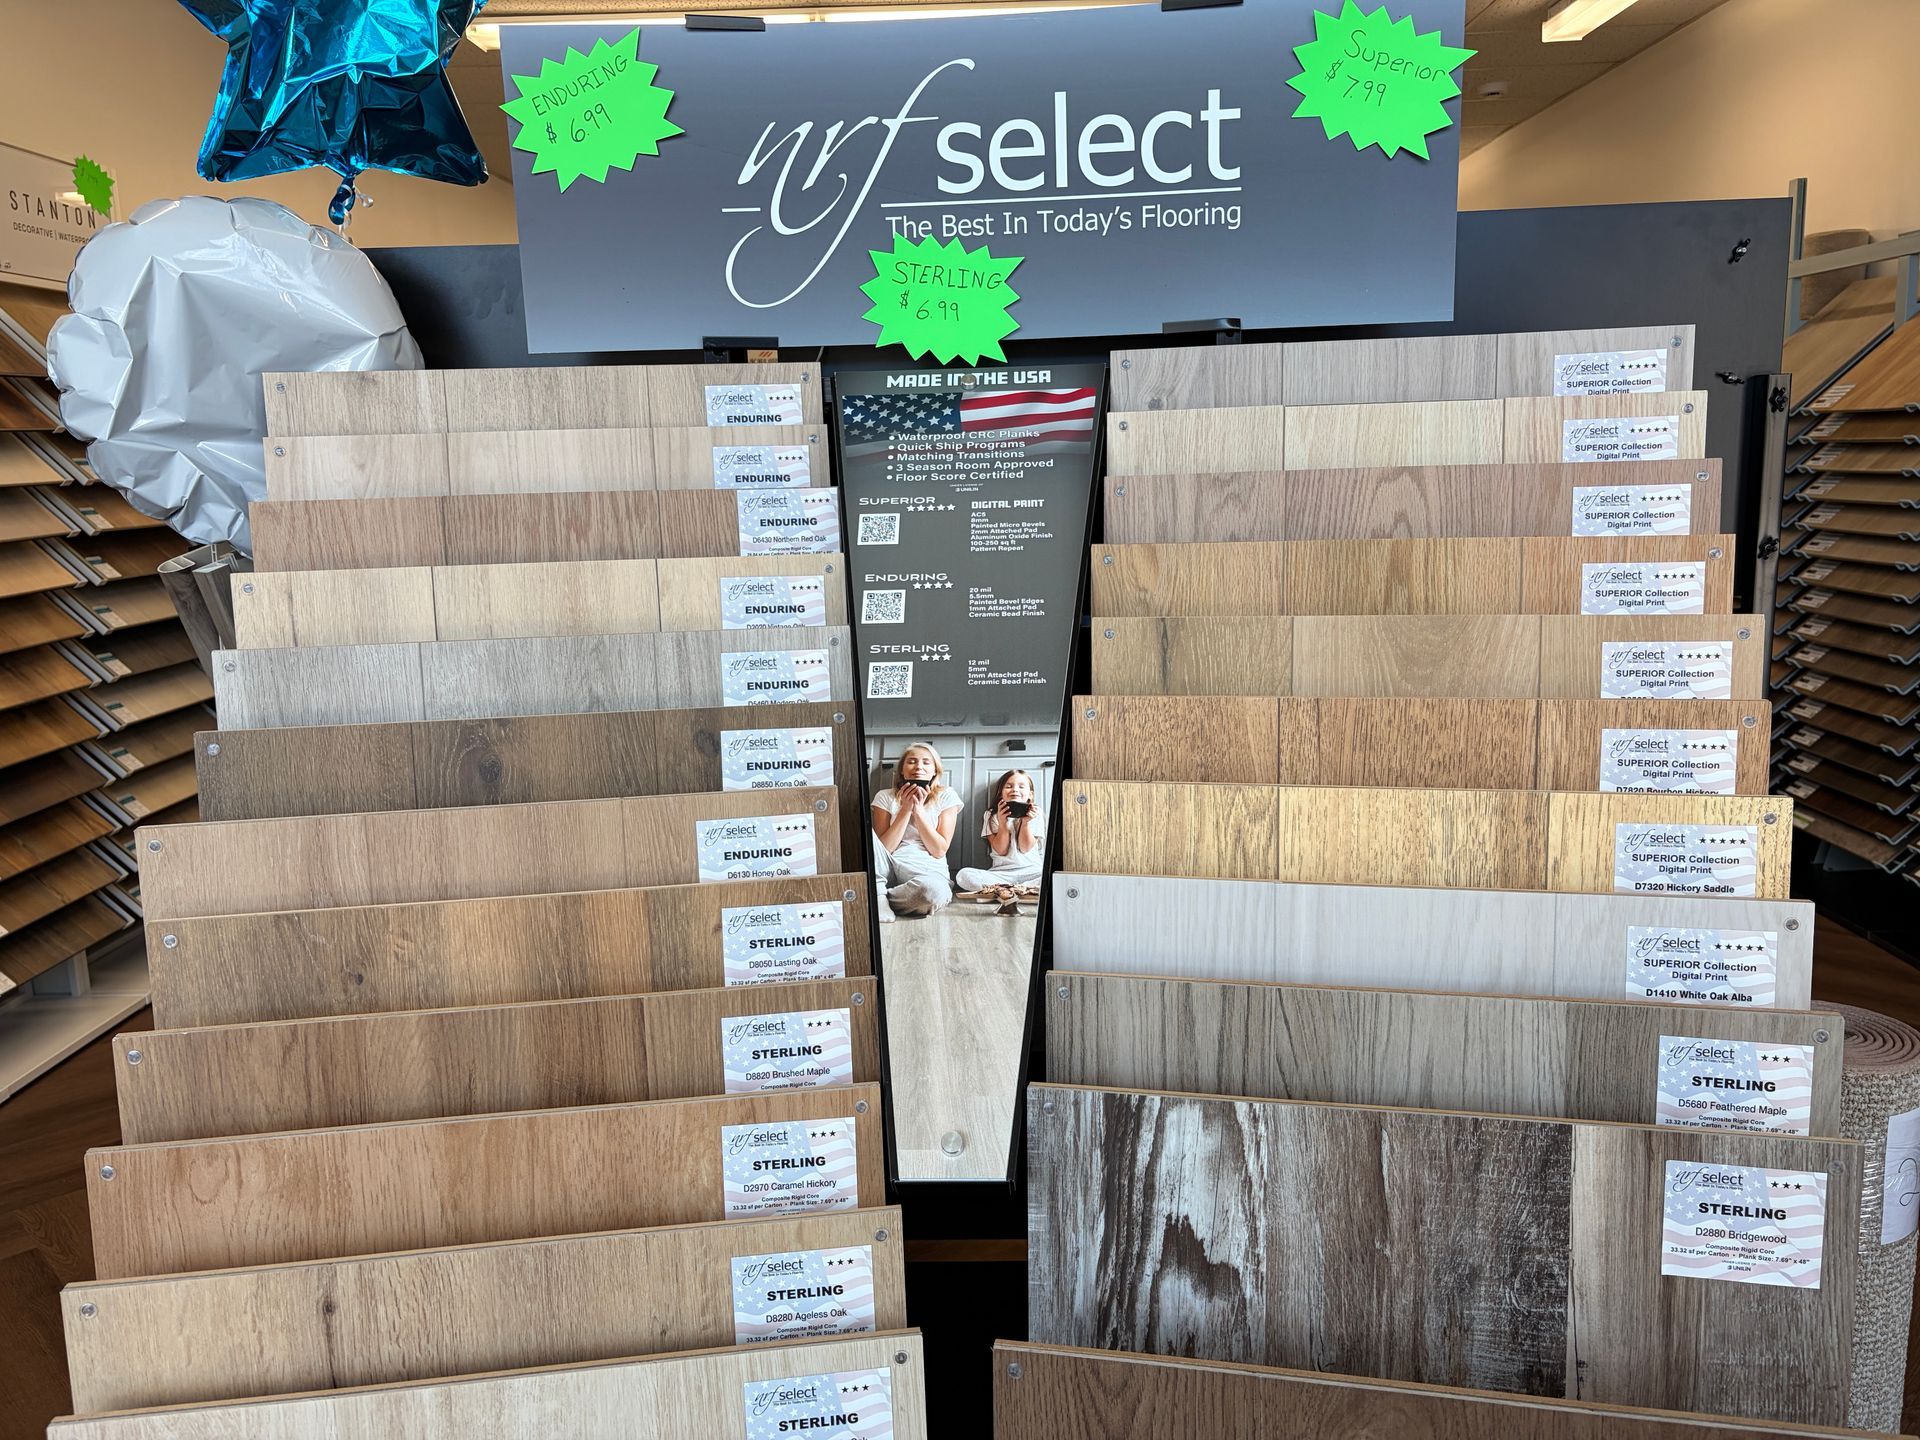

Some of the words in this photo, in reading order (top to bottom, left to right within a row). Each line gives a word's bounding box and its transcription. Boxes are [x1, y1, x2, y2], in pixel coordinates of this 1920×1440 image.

[1344, 30, 1445, 81] Superior
[532, 55, 627, 116] ENDURING
[1325, 59, 1344, 82] $
[1343, 75, 1386, 106] 7.99
[546, 122, 557, 144] $
[571, 103, 612, 142] 6.99
[936, 88, 1241, 194] select
[10, 190, 96, 229] STANTON
[886, 217, 932, 239] The
[942, 214, 994, 237] Best
[1003, 212, 1028, 234] In
[1142, 203, 1241, 230] Flooring
[13, 222, 53, 238] DECORATIVE
[892, 262, 1002, 289] STERLING
[900, 290, 909, 309] $
[916, 300, 959, 321] 6.99
[887, 374, 942, 388] MADE
[975, 372, 1008, 385] THE
[1014, 370, 1051, 384] USA
[727, 415, 782, 423] ENDURING
[898, 431, 965, 442] Waterproof
[969, 431, 995, 439] CRC
[1000, 430, 1040, 438] Planks
[897, 442, 932, 451] Quick
[936, 442, 963, 451] Ship
[966, 441, 1025, 450] Programs
[897, 453, 954, 462] Matching
[957, 451, 1025, 460] Transitions
[896, 464, 903, 472] 3
[907, 463, 951, 471] Season
[956, 461, 990, 470] Room
[994, 459, 1054, 470] Approved
[735, 474, 791, 482] ENDURING
[896, 473, 927, 481] Floor
[931, 472, 966, 481] Score
[970, 470, 1023, 479] Certified
[859, 497, 935, 505] SUPERIOR
[971, 501, 1011, 509] DIGITAL
[1014, 499, 1044, 507] PRINT
[1585, 512, 1630, 520] SUPERIOR
[760, 518, 817, 527] ENDURING
[865, 573, 948, 582] ENDURING
[746, 605, 805, 614] ENDURING
[870, 644, 950, 653] STERLING
[1668, 670, 1714, 678] Collection
[747, 680, 809, 690] ENDURING
[1640, 680, 1667, 688] Digital
[747, 760, 811, 771] ENDURING
[1617, 759, 1668, 767] SUPERIOR
[1672, 761, 1720, 769] Collection
[1643, 770, 1670, 778] Digital
[724, 848, 792, 860] ENDURING
[1632, 854, 1686, 863] SUPERIOR
[1689, 855, 1740, 864] Collection
[728, 871, 750, 879] D6130
[752, 870, 775, 879] Honey
[1659, 866, 1687, 875] Digital
[1690, 866, 1712, 874] Print
[1635, 883, 1664, 891] D7320
[1667, 884, 1701, 893] Hickory
[1704, 885, 1735, 893] Saddle
[749, 936, 816, 949] STERLING
[774, 959, 801, 969] Lasting
[803, 957, 817, 965] Oak
[1643, 959, 1700, 969] SUPERIOR
[1704, 962, 1757, 972] Collection
[1672, 972, 1702, 981] Digital
[1705, 973, 1728, 981] Print
[1646, 989, 1677, 998] D1410
[1680, 991, 1707, 1000] White
[1710, 992, 1728, 1001] Oak
[1731, 993, 1752, 1002] Alba
[752, 1045, 822, 1060] STERLING
[773, 1069, 805, 1079] Brushed
[807, 1067, 830, 1077] Maple
[1692, 1076, 1776, 1092] STERLING
[1678, 1099, 1707, 1109] D5680
[1710, 1102, 1756, 1113] Feathered
[1758, 1106, 1787, 1116] Maple
[753, 1156, 826, 1171] STERLING
[744, 1183, 769, 1192] D2970
[771, 1182, 805, 1191] Caramel
[807, 1180, 837, 1189] Hickory
[1699, 1203, 1787, 1220] STERLING
[1695, 1227, 1725, 1238] D2880
[1728, 1231, 1787, 1244] Bridgewood
[767, 1284, 844, 1301] STERLING
[766, 1314, 792, 1323] D8280
[795, 1311, 828, 1322] Ageless
[830, 1308, 847, 1317] Oak
[779, 1412, 859, 1432] STERLING
